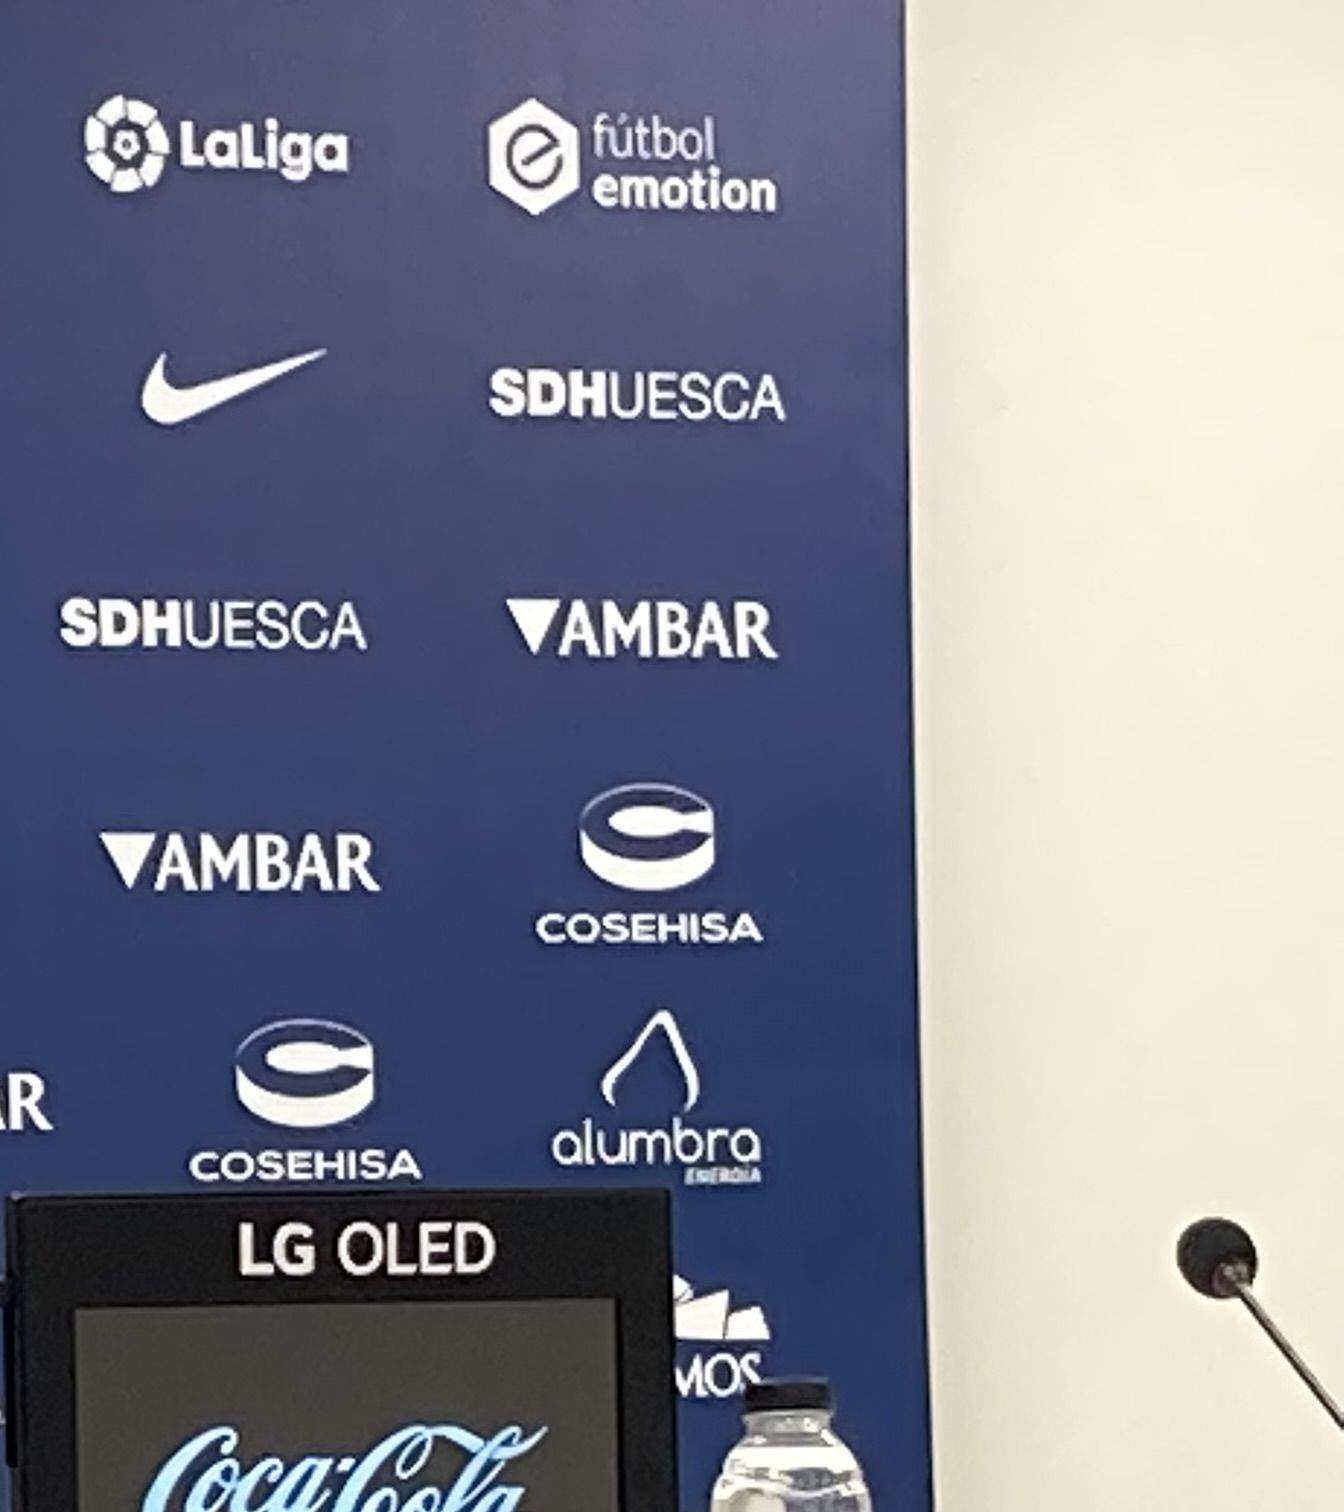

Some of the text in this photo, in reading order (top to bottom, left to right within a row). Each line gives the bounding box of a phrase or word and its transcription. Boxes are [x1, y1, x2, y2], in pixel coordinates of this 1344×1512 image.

[180, 117, 348, 182] LaLiga
[593, 112, 716, 162] fútbol
[592, 167, 777, 212] emotion
[489, 367, 786, 421] SDHUESCA
[60, 597, 368, 650] SDHUESCA
[558, 599, 779, 659] AMBAR
[153, 832, 381, 892] AMBAR
[536, 912, 764, 943] COSEHISA
[189, 1149, 422, 1182] COSEHISA
[552, 1117, 761, 1165] alumbra
[239, 1221, 496, 1276] LG OLED
